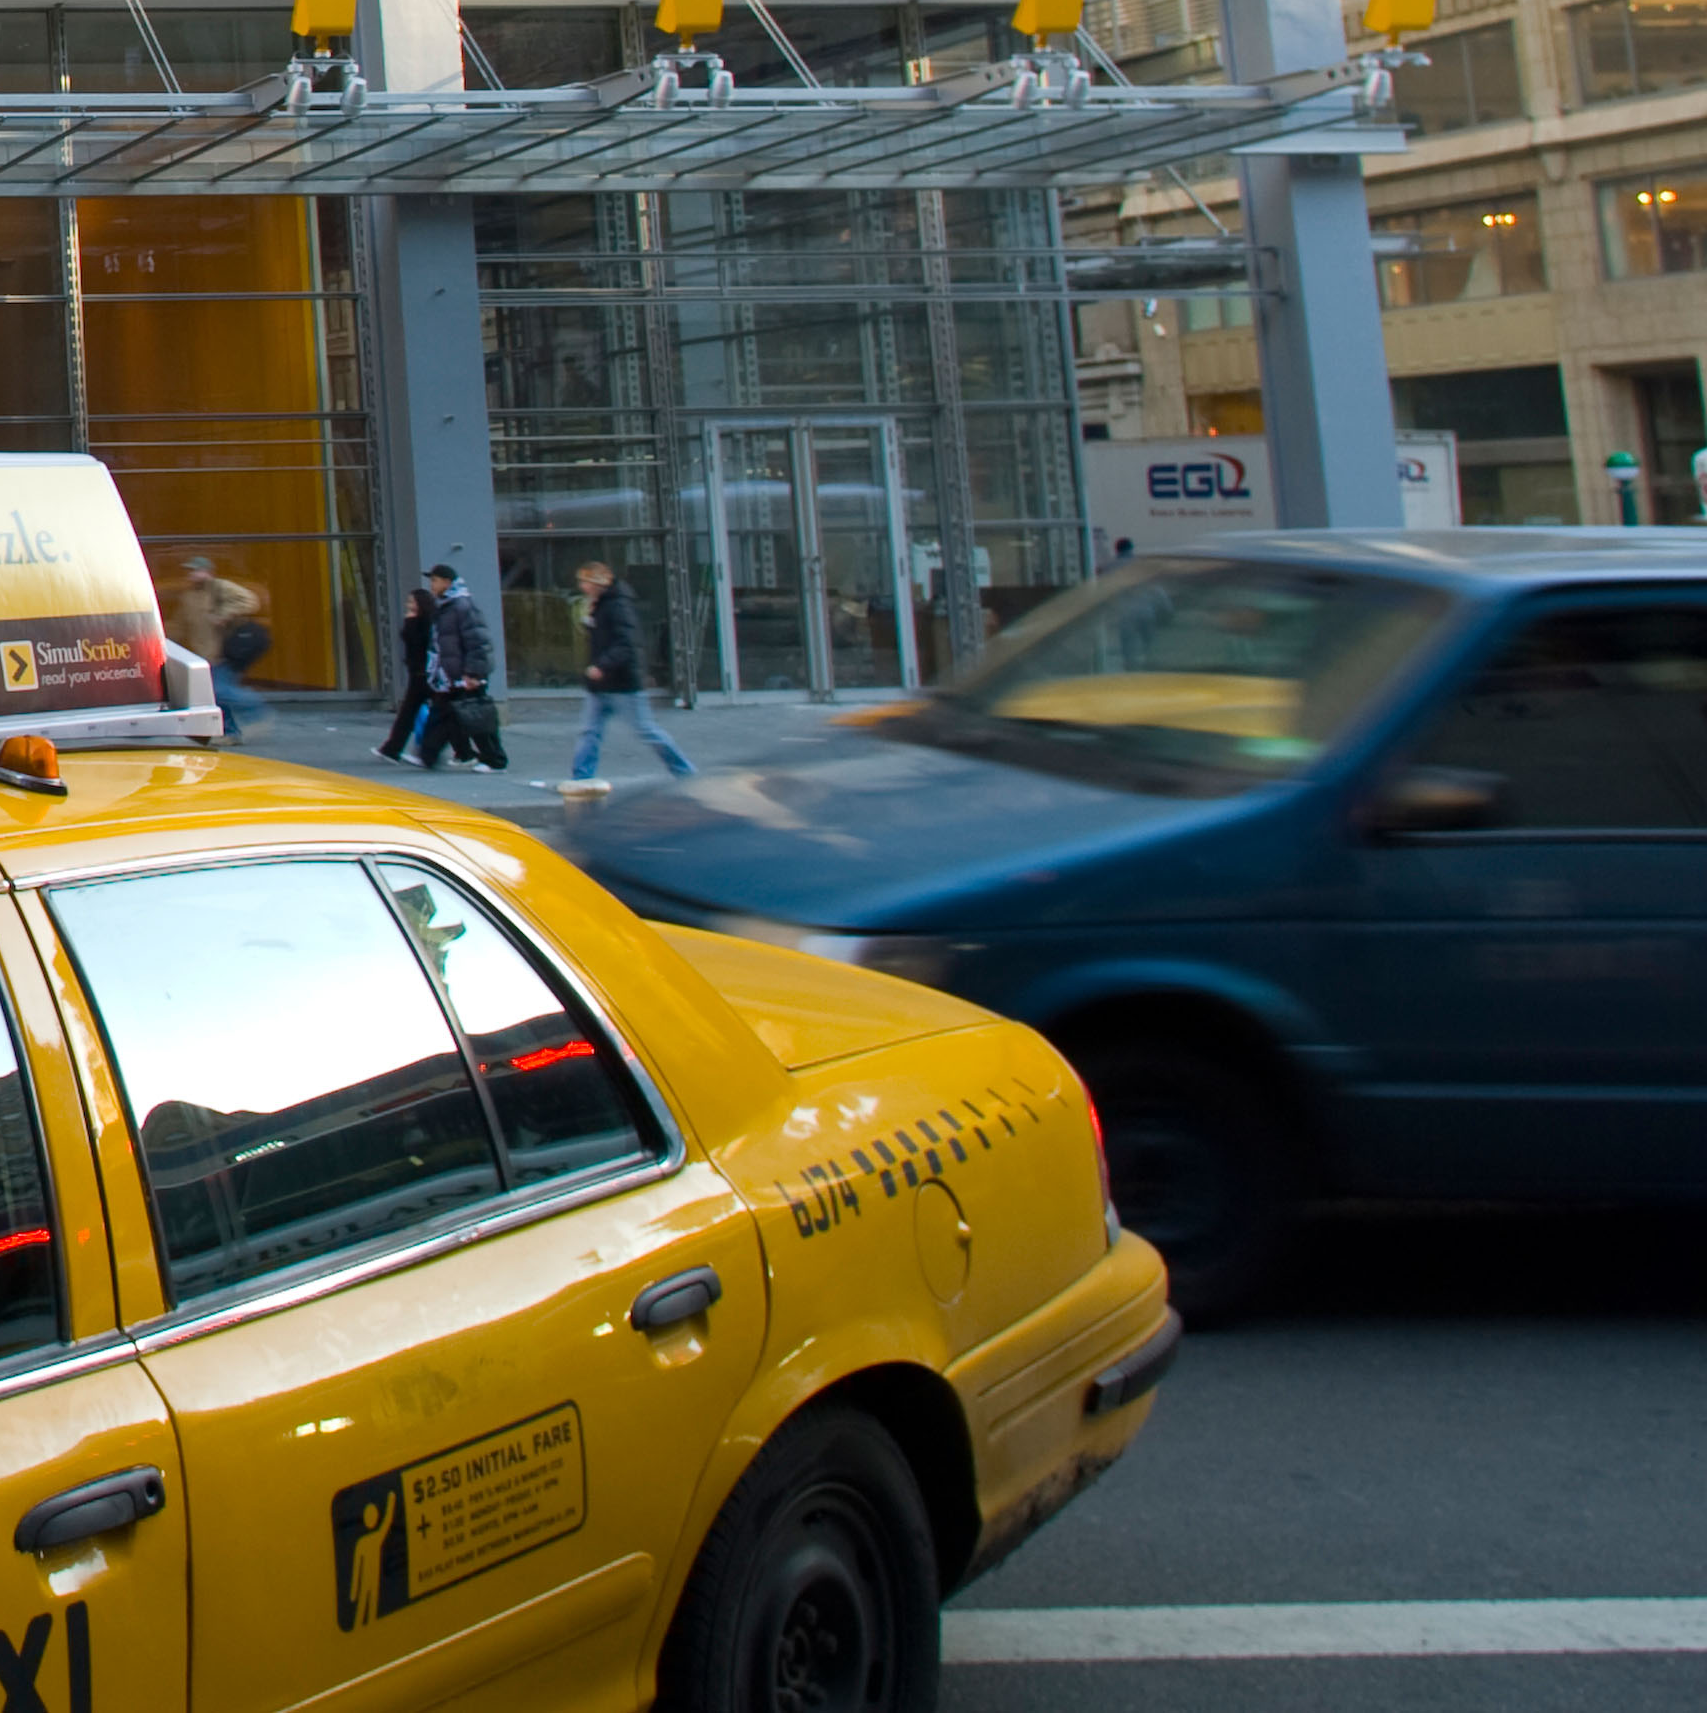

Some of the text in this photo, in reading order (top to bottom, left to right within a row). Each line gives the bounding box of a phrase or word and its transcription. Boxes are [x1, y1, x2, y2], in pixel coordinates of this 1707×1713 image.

[1147, 458, 1251, 499] EGL
[36, 638, 131, 665] SimulScribe
[42, 667, 66, 685] read
[68, 671, 91, 688] your
[774, 1158, 861, 1238] 6J74
[413, 1466, 462, 1504] $2.50
[466, 1441, 527, 1483] INITIAL
[533, 1420, 572, 1456] FARE
